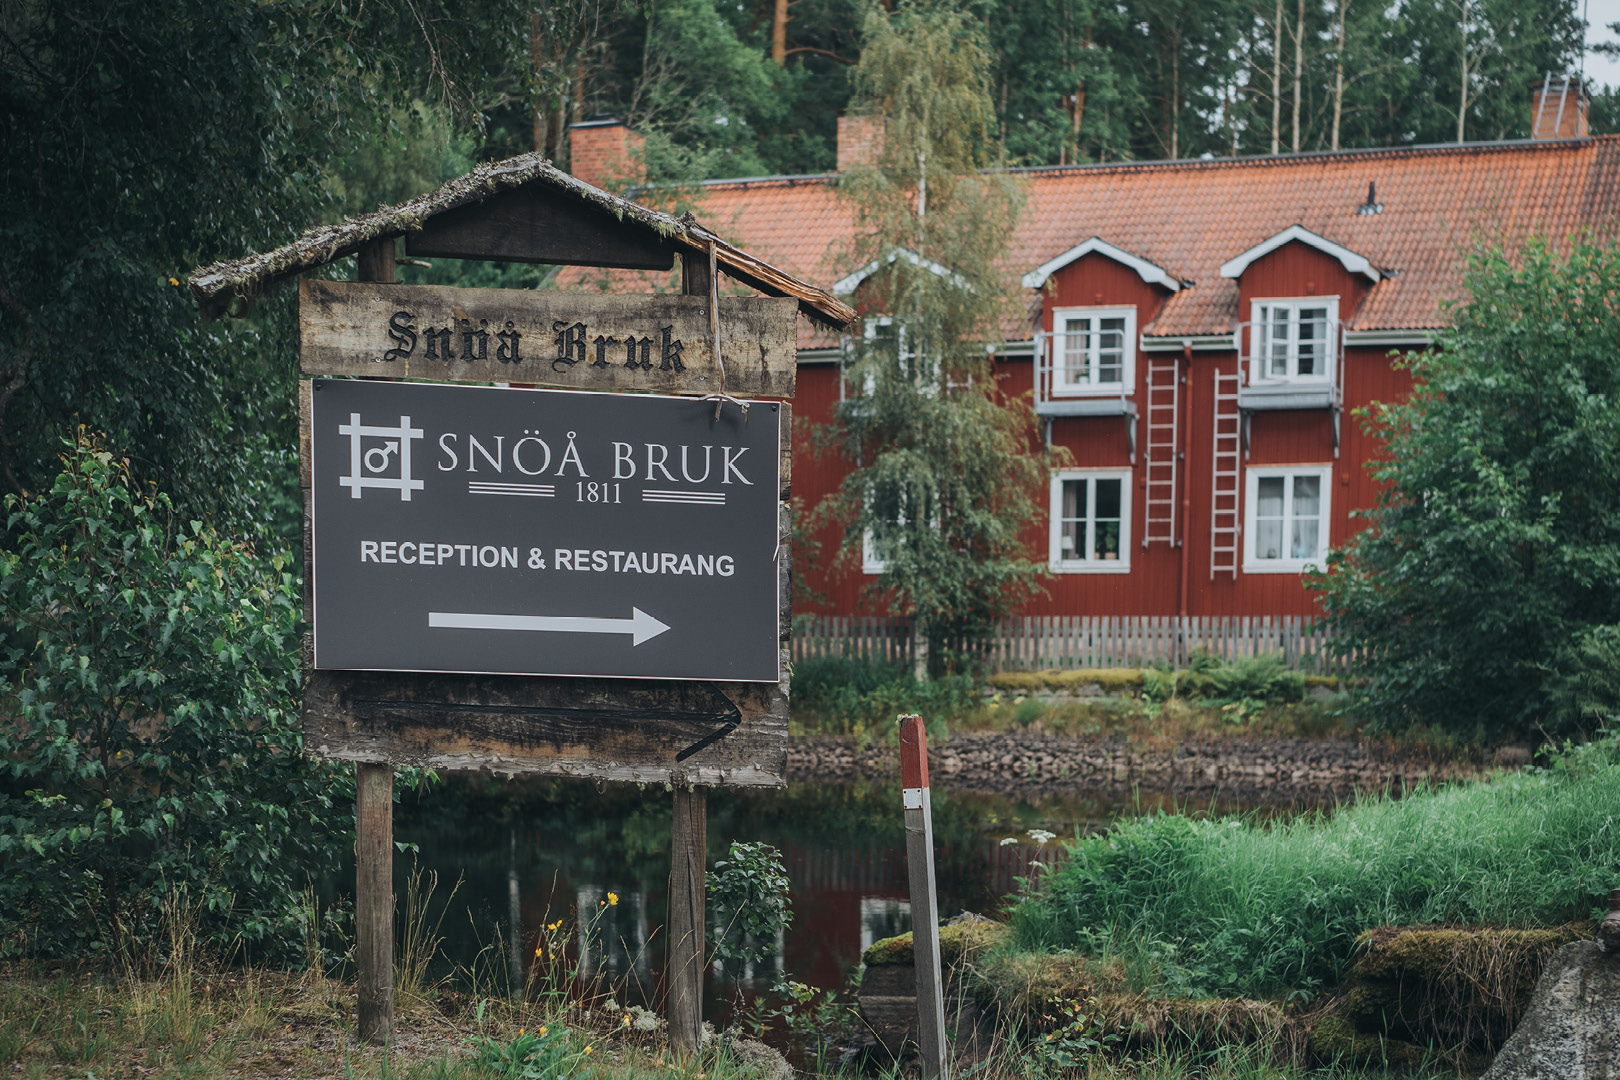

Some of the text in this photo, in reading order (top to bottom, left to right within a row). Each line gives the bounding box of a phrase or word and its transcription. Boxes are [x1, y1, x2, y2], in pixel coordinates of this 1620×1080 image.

[384, 310, 687, 374] Snöå Bruk
[437, 429, 754, 486] SNÖÅ BRUK
[575, 481, 622, 504] 1811
[360, 540, 735, 577] RECEPTION & RESTAURANG
